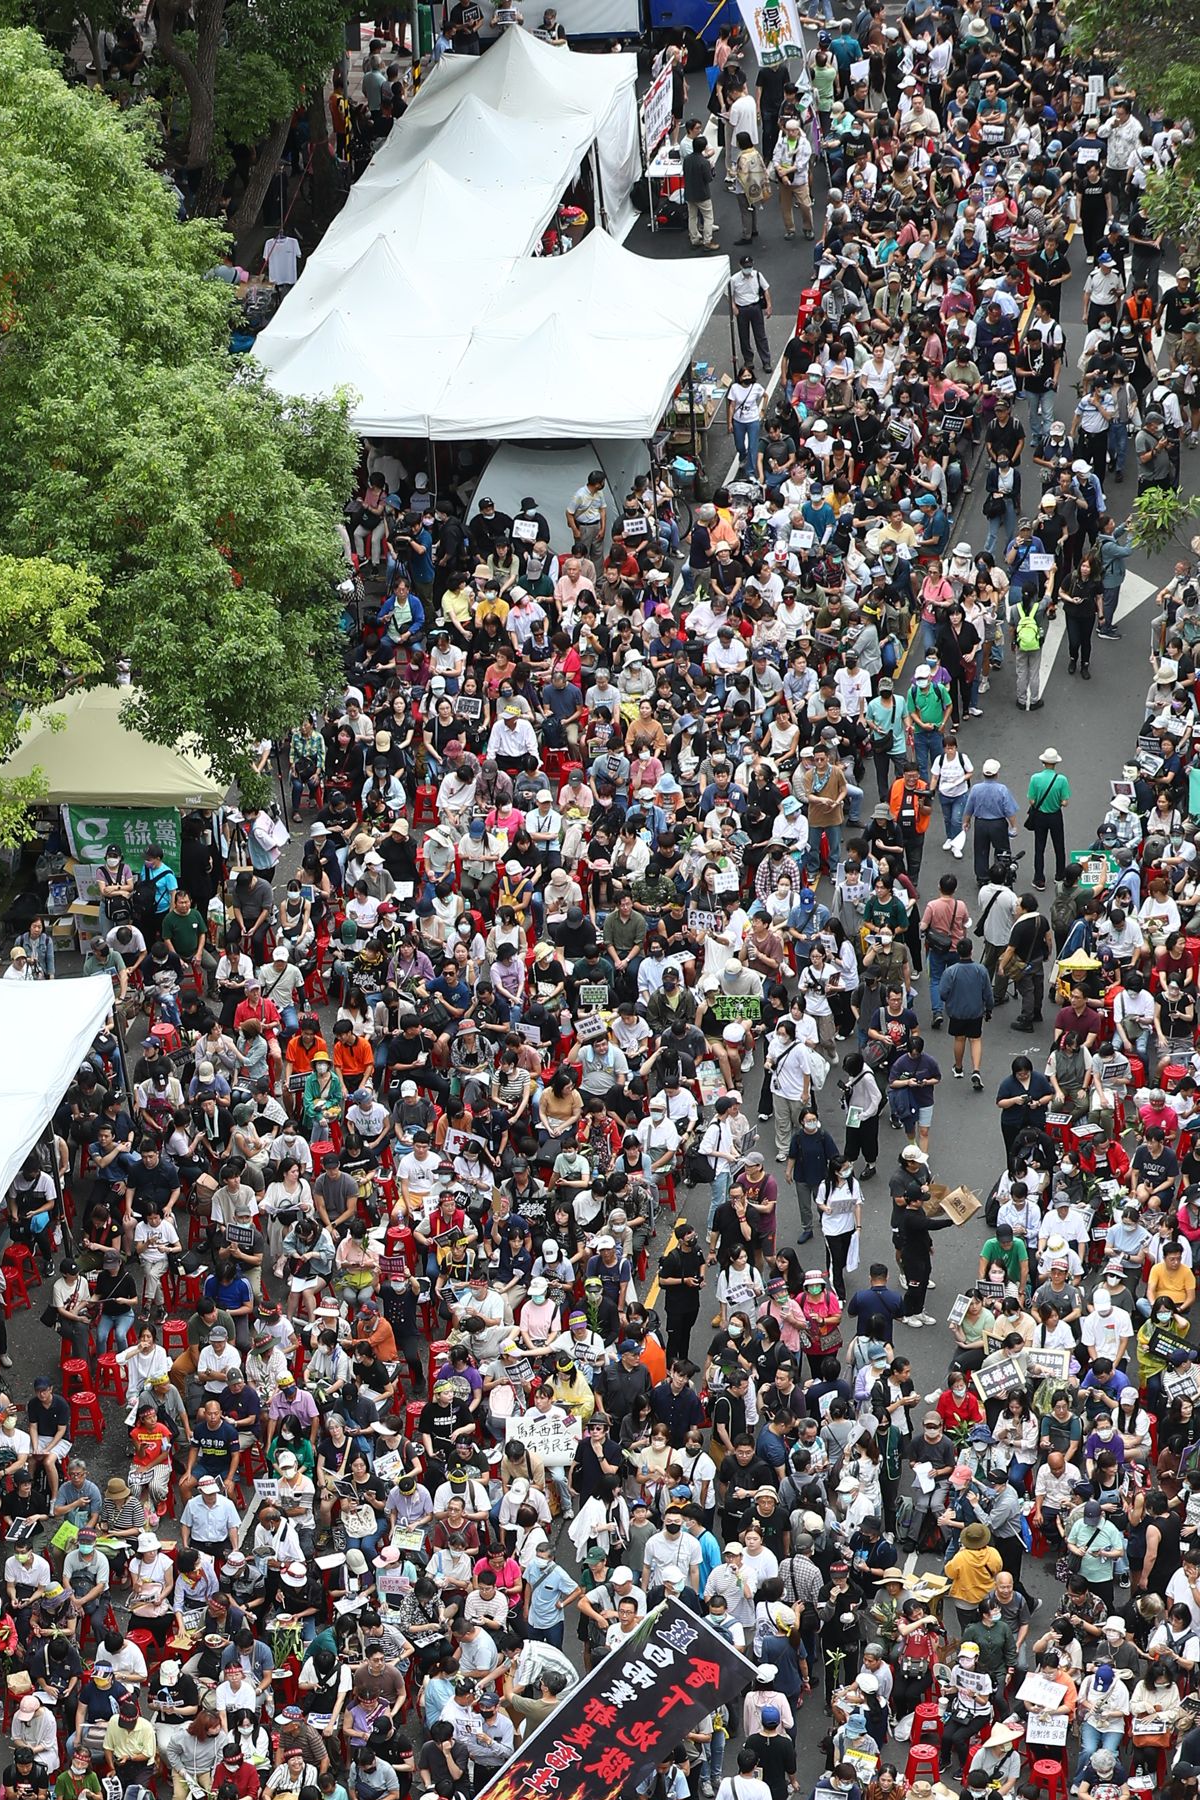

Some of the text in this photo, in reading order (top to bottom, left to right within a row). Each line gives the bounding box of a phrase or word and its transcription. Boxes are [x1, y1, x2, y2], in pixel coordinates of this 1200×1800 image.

[123, 818, 177, 847] 綠黨
[1143, 1162, 1166, 1172] ROOTS
[1029, 1351, 1063, 1364] 沒有討論
[980, 1363, 1017, 1389] 我藐視
